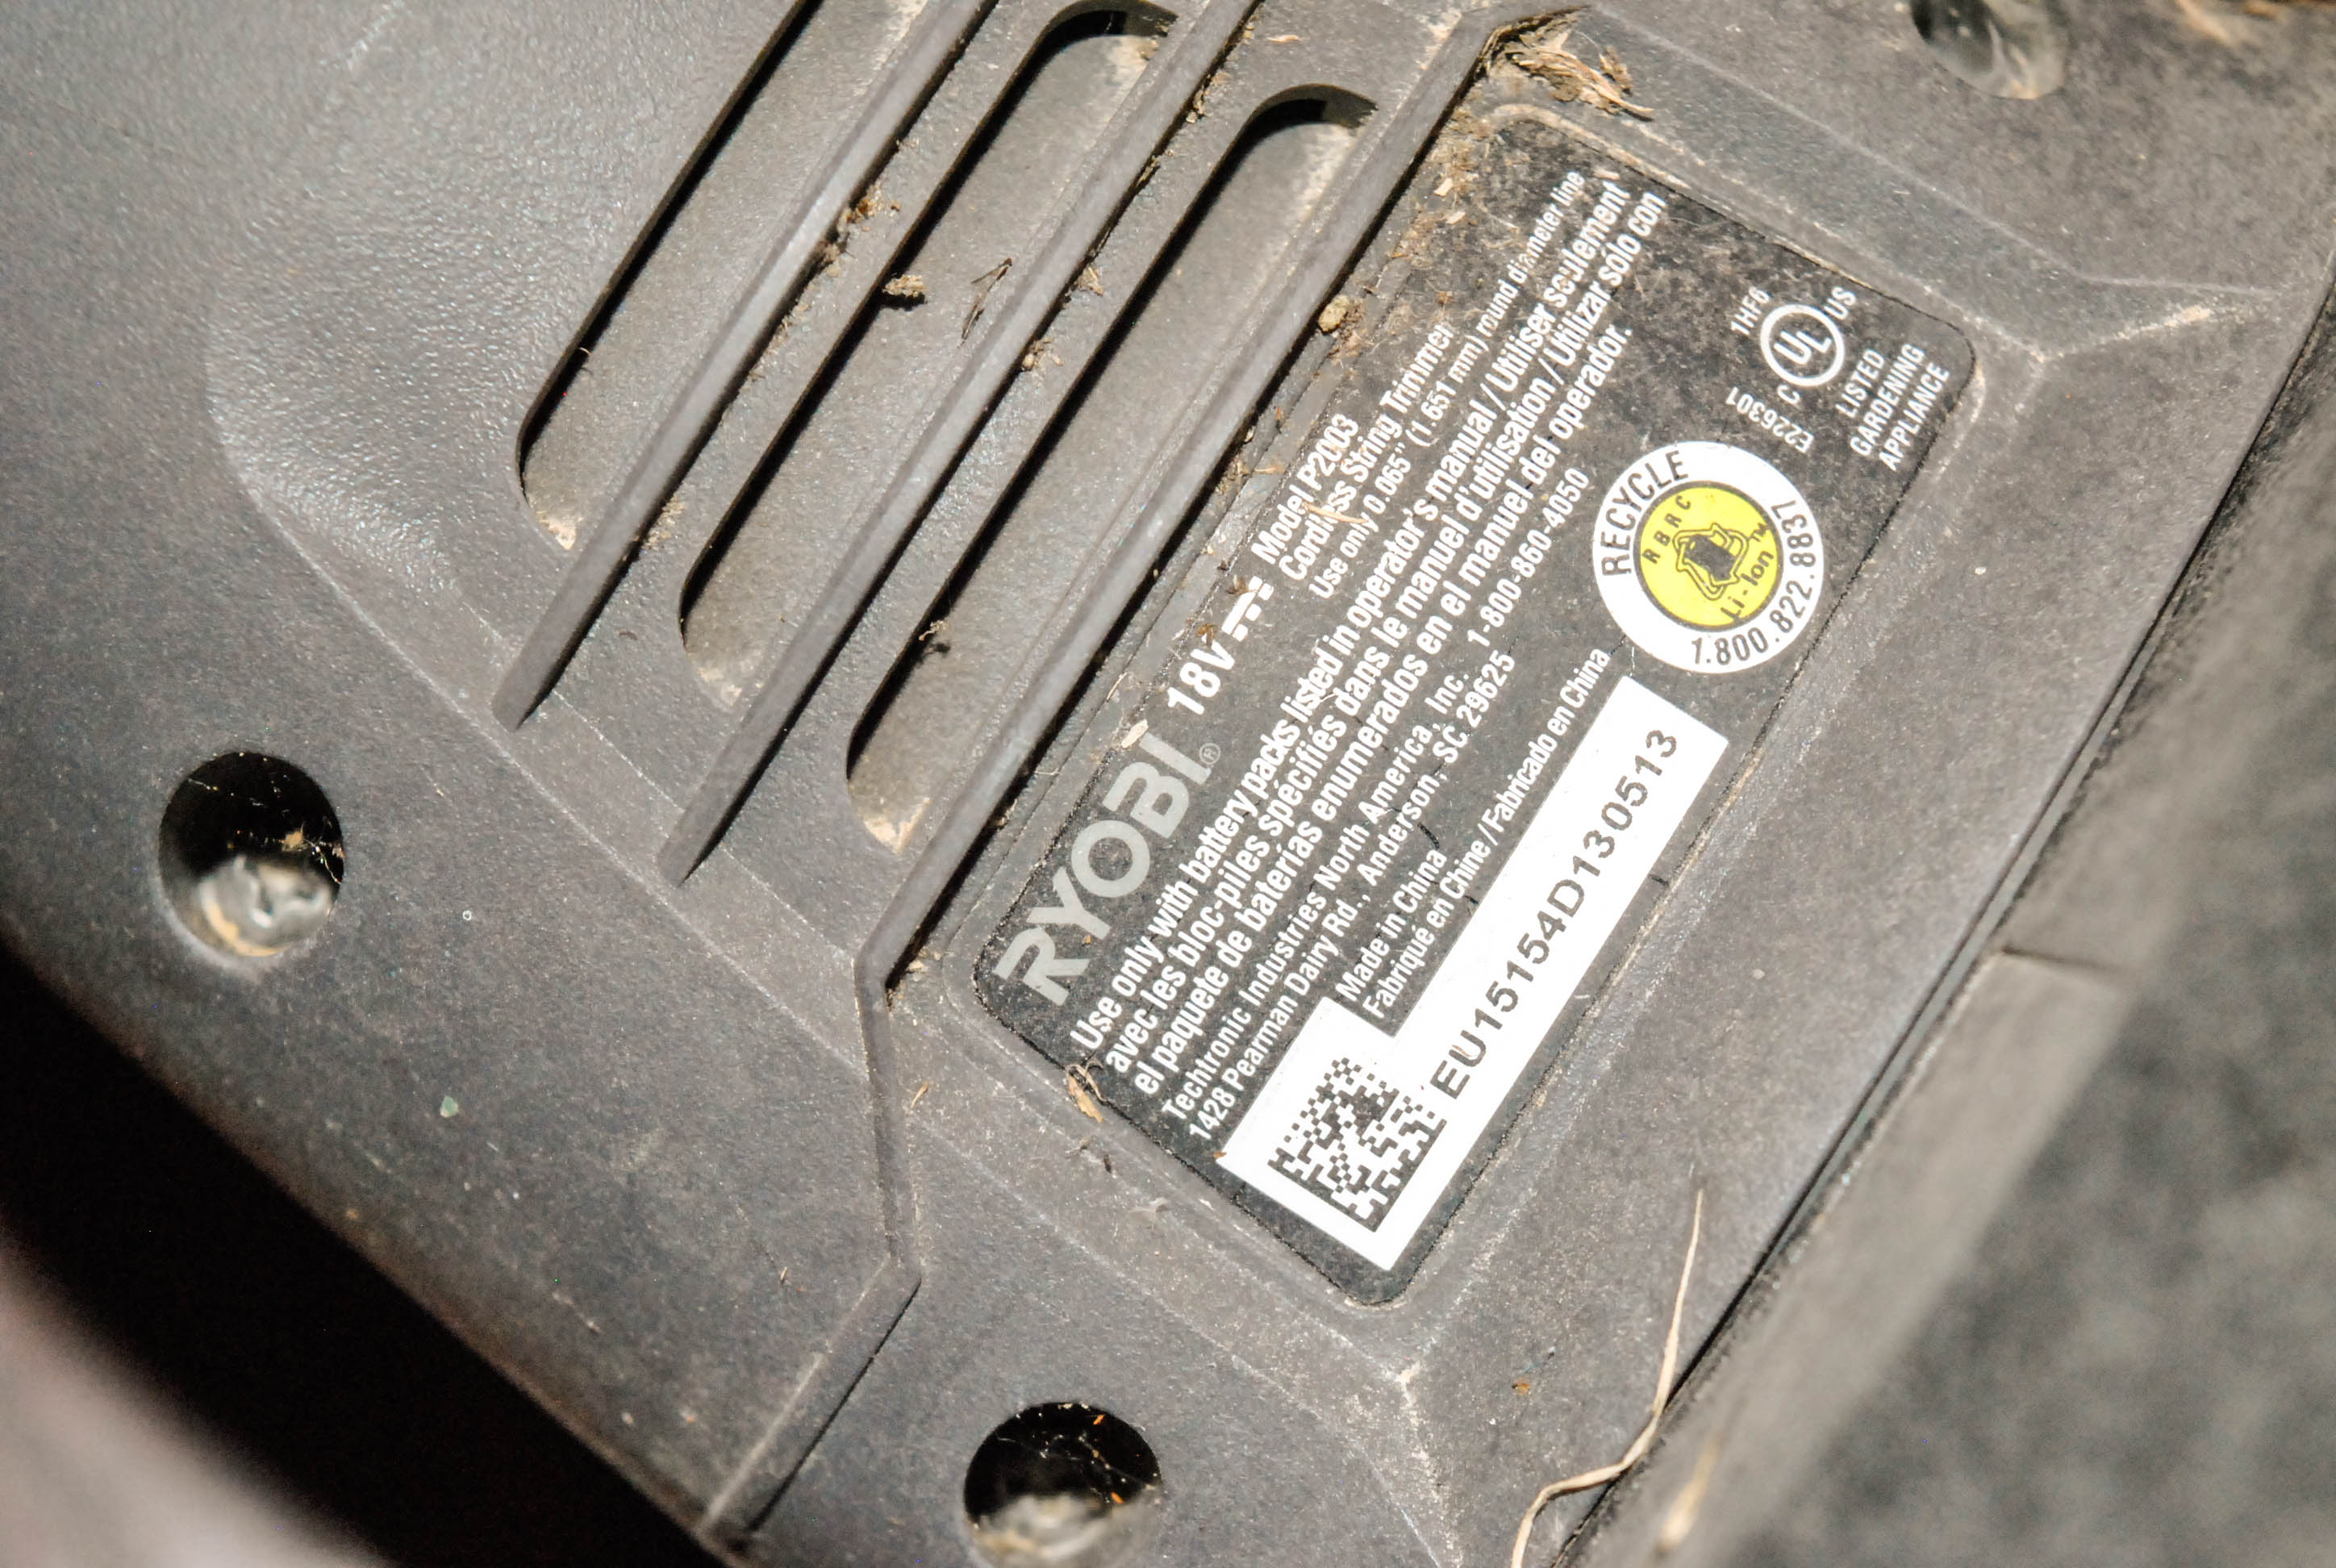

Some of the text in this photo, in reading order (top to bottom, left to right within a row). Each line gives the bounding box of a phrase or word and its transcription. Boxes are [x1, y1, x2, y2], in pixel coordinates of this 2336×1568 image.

[1729, 285, 1771, 336] 1HF6
[1773, 330, 1833, 365] UL
[1822, 286, 1858, 321] US
[1308, 556, 1349, 599] Use
[1338, 511, 1379, 559] only
[1475, 277, 1520, 338] round
[1505, 202, 1565, 285] diameter
[1549, 171, 1587, 207] line
[1339, 413, 1404, 484] String
[1378, 321, 1454, 415] Trimmer
[1725, 386, 1815, 454] E226301
[1834, 348, 1886, 419] LISTED
[1849, 343, 1926, 457] GARDENING
[1877, 361, 1950, 472] APPLIANCE
[1249, 412, 1360, 565] Model P2003
[1599, 449, 1690, 577] RECYCLE
[1069, 995, 1124, 1050] Use
[1111, 934, 1166, 998] only
[1146, 879, 1199, 938] with
[1177, 788, 1259, 884] battery
[1240, 718, 1307, 801] packs
[1279, 646, 1344, 724] listed
[1321, 623, 1362, 657] in
[1345, 498, 1448, 635] operator's
[1424, 398, 1499, 503] manual
[1541, 179, 1631, 309] seulement
[1104, 1007, 1159, 1074] avec
[1139, 965, 1187, 1010] les
[1166, 834, 1271, 968] bloc-piles
[1250, 714, 1348, 837] spécifiés
[1332, 645, 1391, 716] dans
[1370, 610, 1410, 648] le
[1394, 513, 1470, 619] manuel
[1453, 377, 1557, 522] d'utilisation
[1596, 233, 1642, 287] sólo
[1626, 191, 1667, 237] con
[1691, 499, 1817, 667] 1.800.822.8837
[1133, 323, 1633, 1095] el paquete de baterías enumerados en el manuel del operador.
[1166, 637, 1237, 715] 18V
[1546, 705, 1576, 737] en
[1558, 648, 1612, 709] China
[1160, 467, 1590, 1120] Techtronic Industries North America, Inc. 1-800-860-4050
[1188, 648, 1516, 1141] 1428 Pearman Dairy Rd., Anderson, SC 29625
[1334, 849, 1448, 1003] Made in China
[1425, 897, 1455, 929] en
[1429, 729, 1678, 1100] EU15154D130513
[1438, 839, 1492, 900] Chine
[1361, 924, 1437, 1020] Fabriqué
